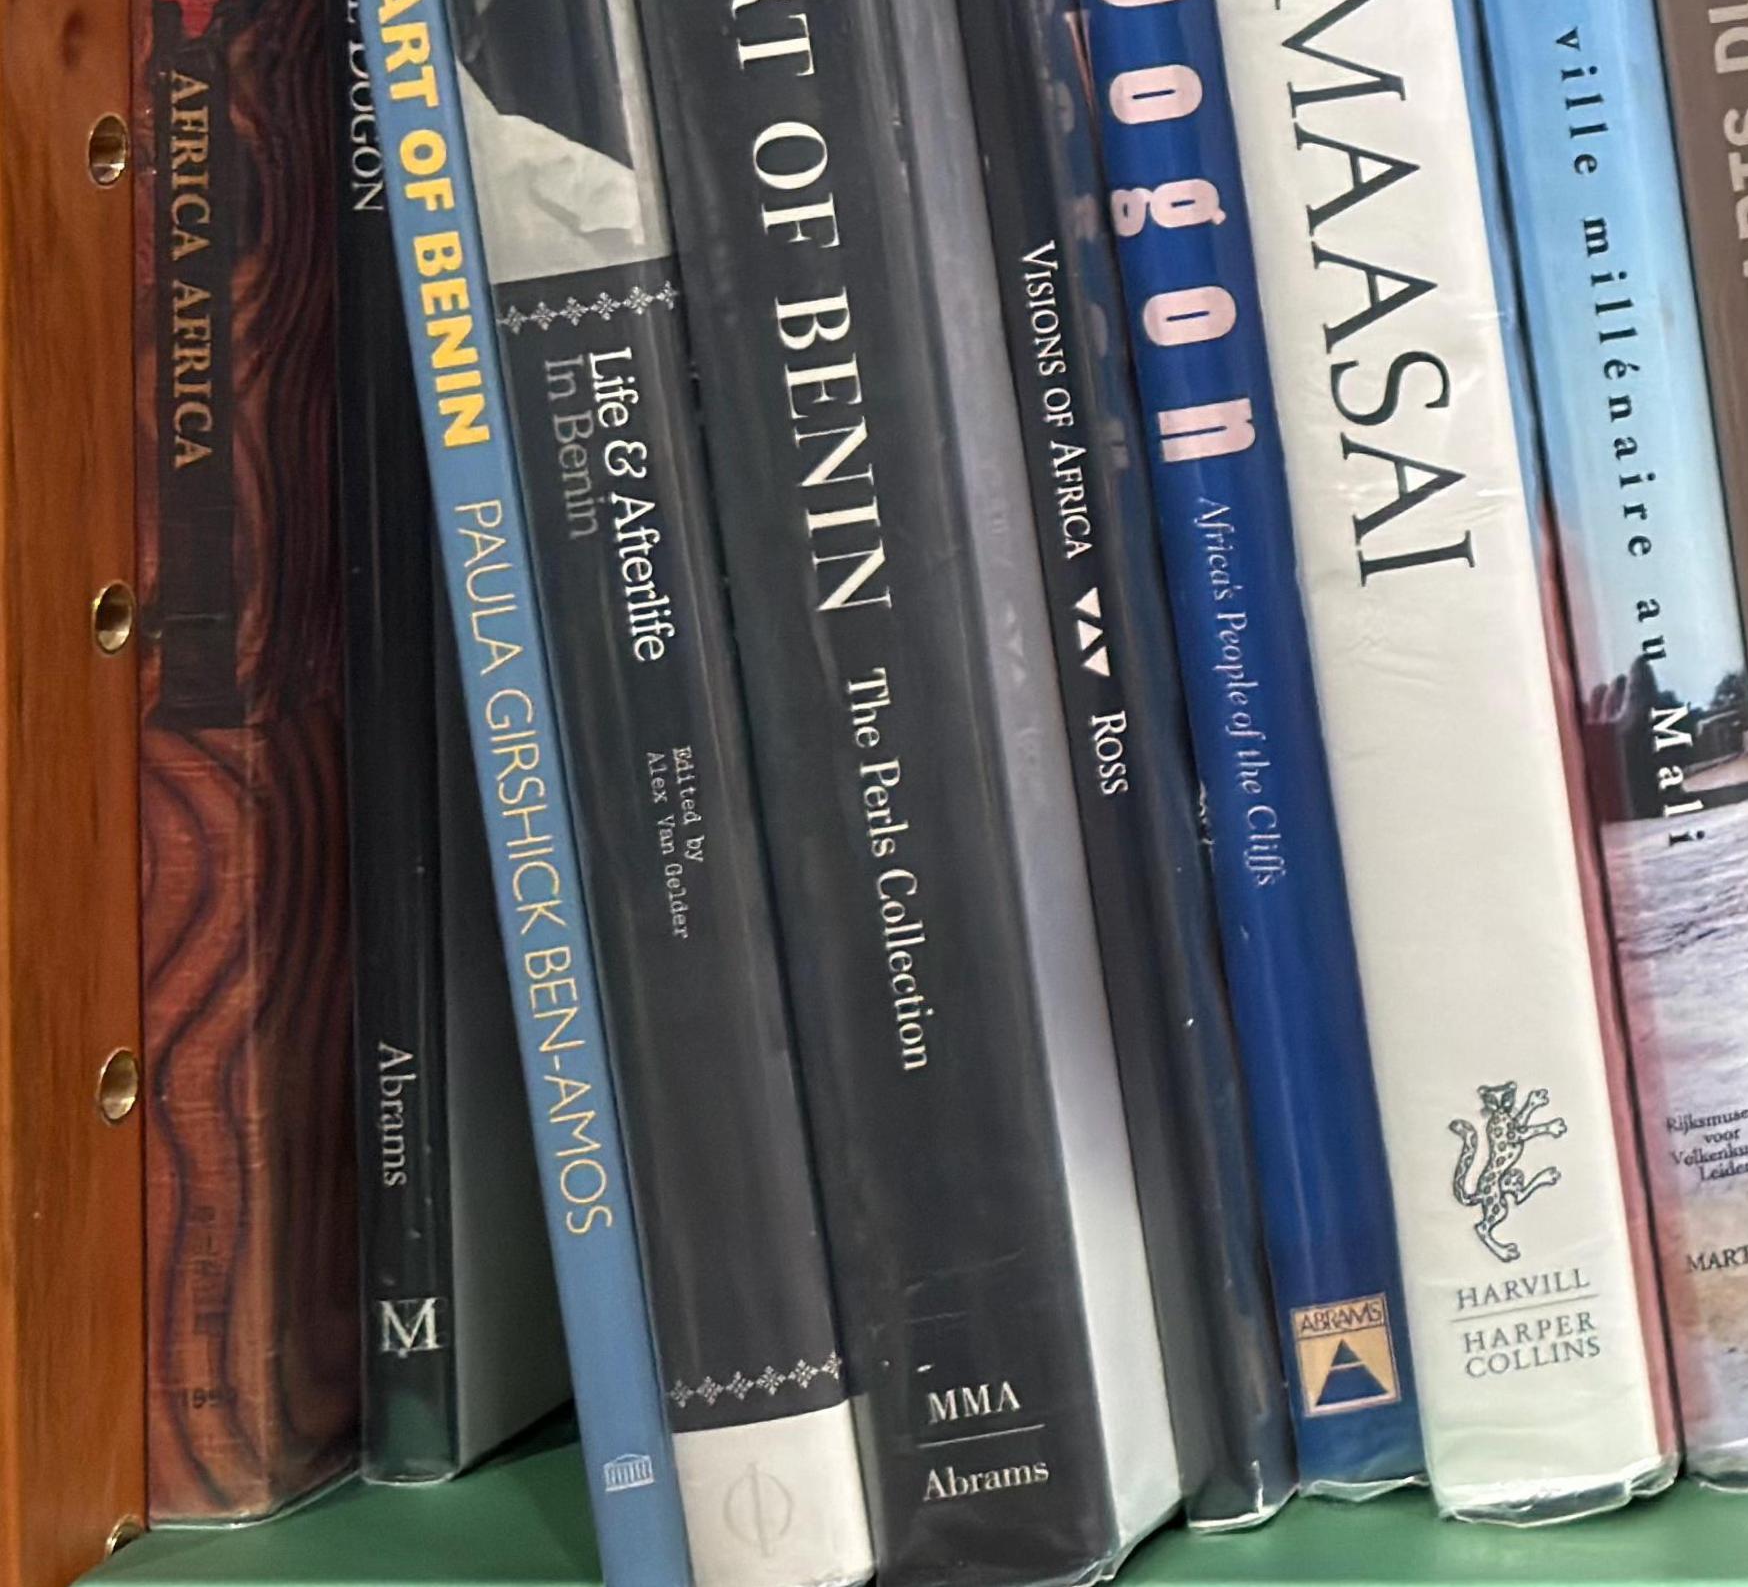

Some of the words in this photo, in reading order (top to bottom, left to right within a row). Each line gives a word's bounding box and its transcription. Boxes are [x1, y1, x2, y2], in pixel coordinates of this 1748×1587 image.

[168, 70, 212, 261] AFRICA
[401, 129, 455, 214] OF
[1553, 26, 1607, 176] ville
[750, 124, 842, 250] OF
[171, 280, 215, 469] AFRICA
[413, 229, 491, 450] BENIN
[589, 346, 640, 430] Life
[1581, 217, 1656, 559] millénaire
[603, 440, 648, 480] &
[774, 286, 895, 612] BENIN
[453, 497, 525, 677] PAULA
[611, 490, 667, 664] Afterlife
[1635, 597, 1668, 662] au
[483, 688, 566, 937] GIRSHICK
[646, 752, 667, 806] Alex
[657, 814, 678, 857] Van
[672, 745, 701, 825] Edited
[1650, 702, 1706, 846] Mali
[664, 862, 689, 941] Gelder
[685, 831, 705, 863] by
[376, 1042, 416, 1188] Abrams
[523, 947, 614, 1236] BEN-AMOS
